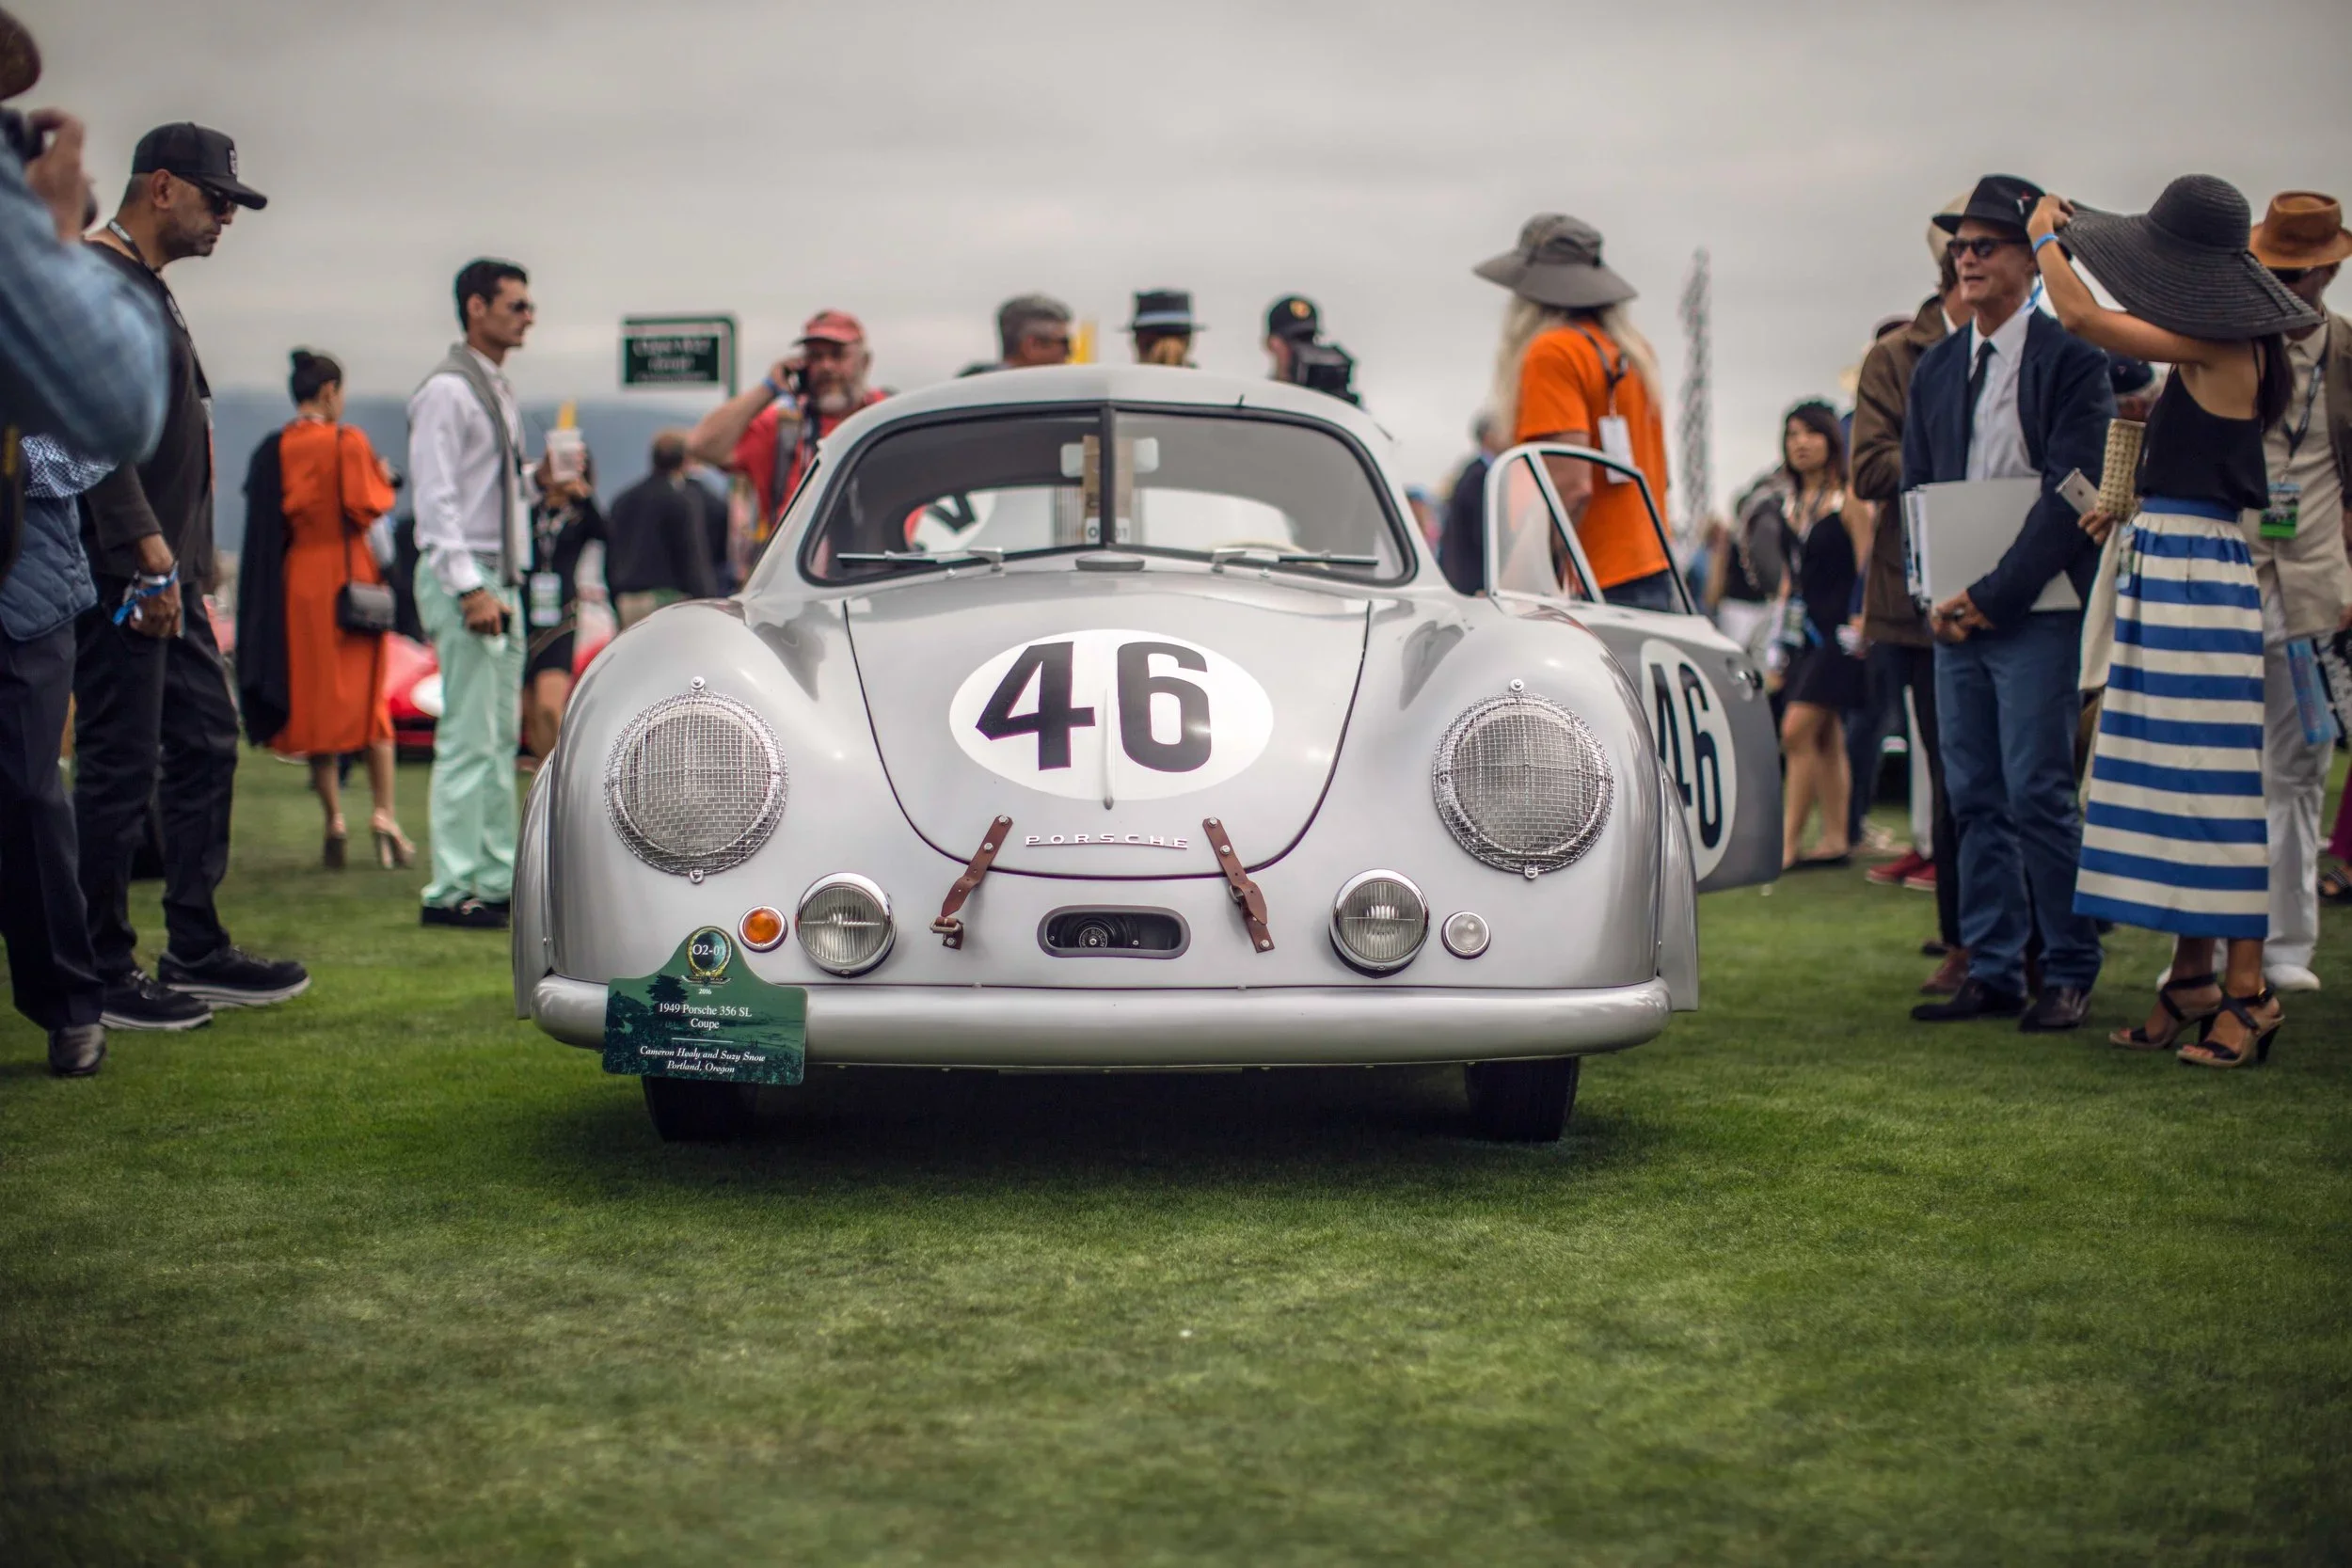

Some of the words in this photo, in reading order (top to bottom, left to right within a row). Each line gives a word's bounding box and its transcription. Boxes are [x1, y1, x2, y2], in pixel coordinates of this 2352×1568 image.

[976, 641, 1212, 772] 46
[1025, 833, 1188, 848] PORSCHE
[659, 1003, 681, 1013] 1949
[682, 1004, 718, 1015] Porsche
[719, 1006, 737, 1016] 356
[739, 1007, 752, 1017] SL
[691, 1018, 720, 1030] Coupe
[640, 1045, 675, 1057] Cameron
[676, 1047, 701, 1060] Healy
[702, 1049, 720, 1059] and
[721, 1051, 741, 1062] Suzy
[742, 1052, 766, 1062] Snow
[666, 1060, 703, 1072] Portland,
[705, 1063, 735, 1074] Oregon
